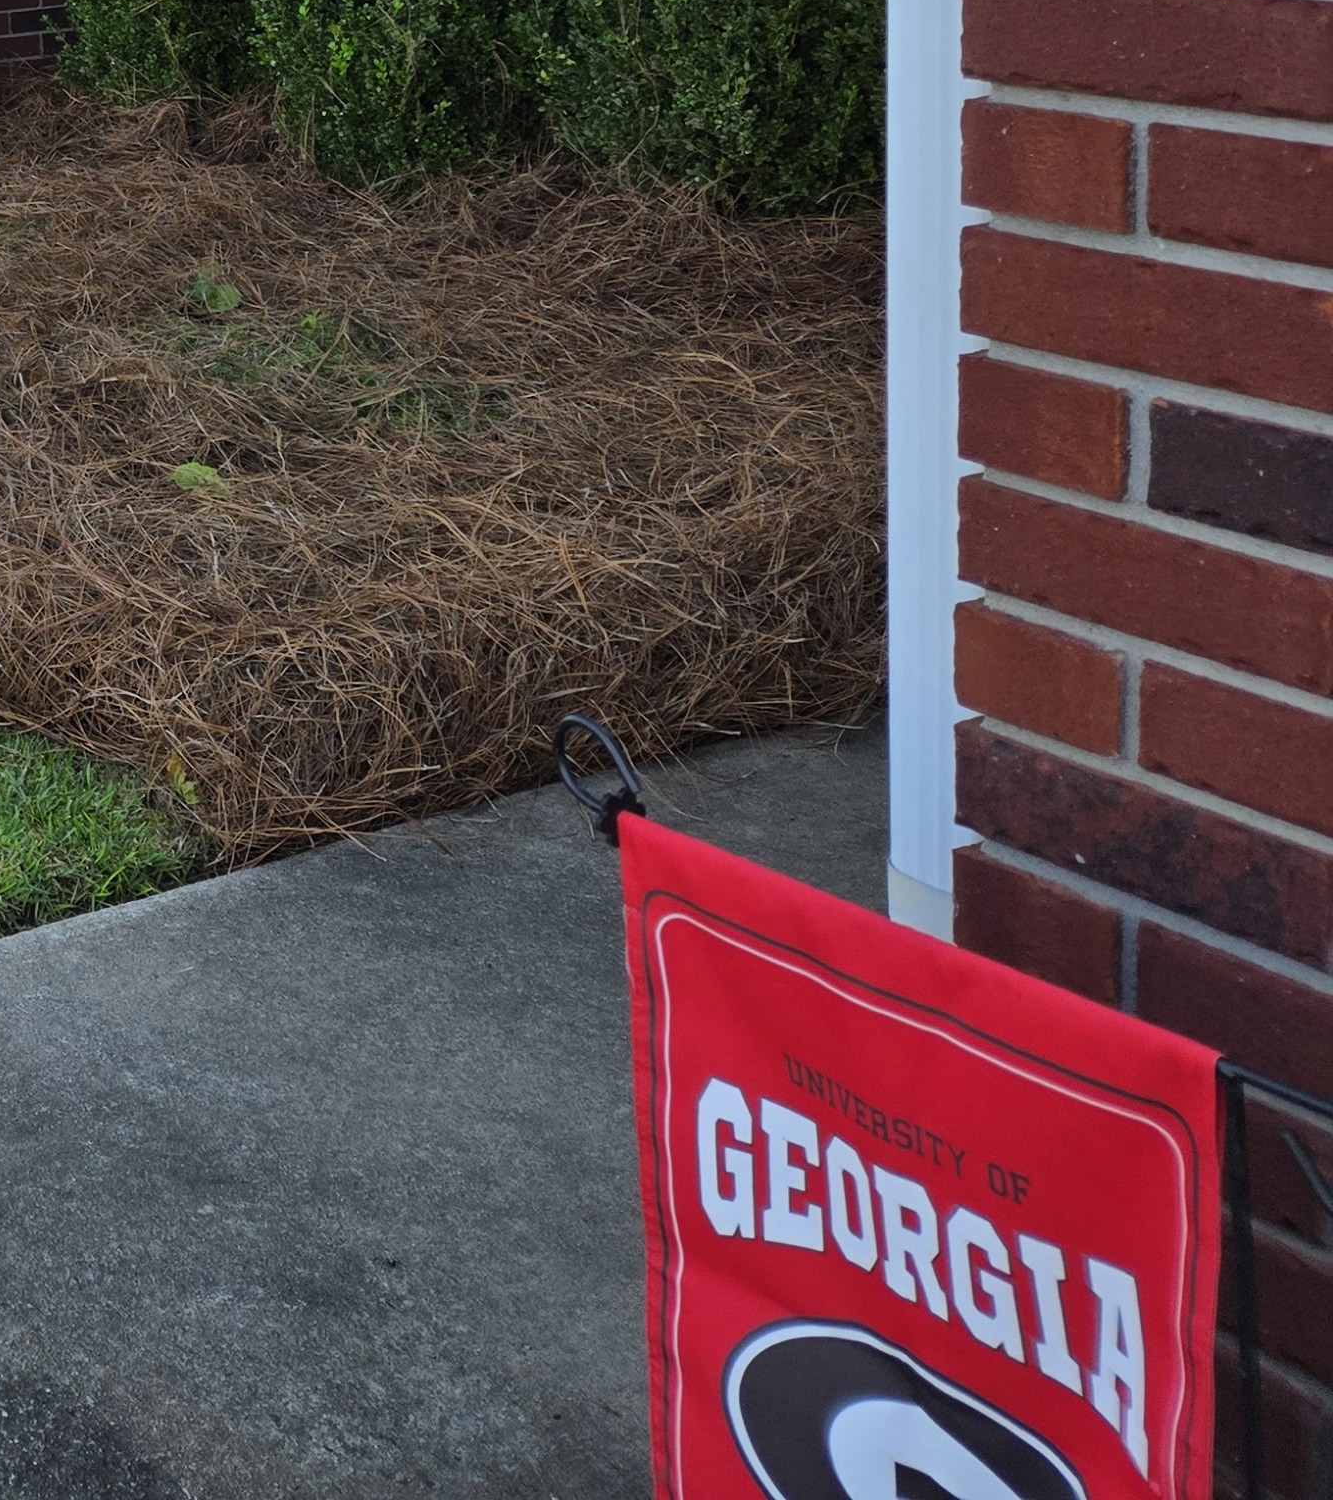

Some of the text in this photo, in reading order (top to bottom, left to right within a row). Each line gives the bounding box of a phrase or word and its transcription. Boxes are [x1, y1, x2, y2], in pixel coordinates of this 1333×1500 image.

[784, 1054, 1032, 1205] UNIVERSITY OF
[697, 1078, 1149, 1481] GEORGIA
